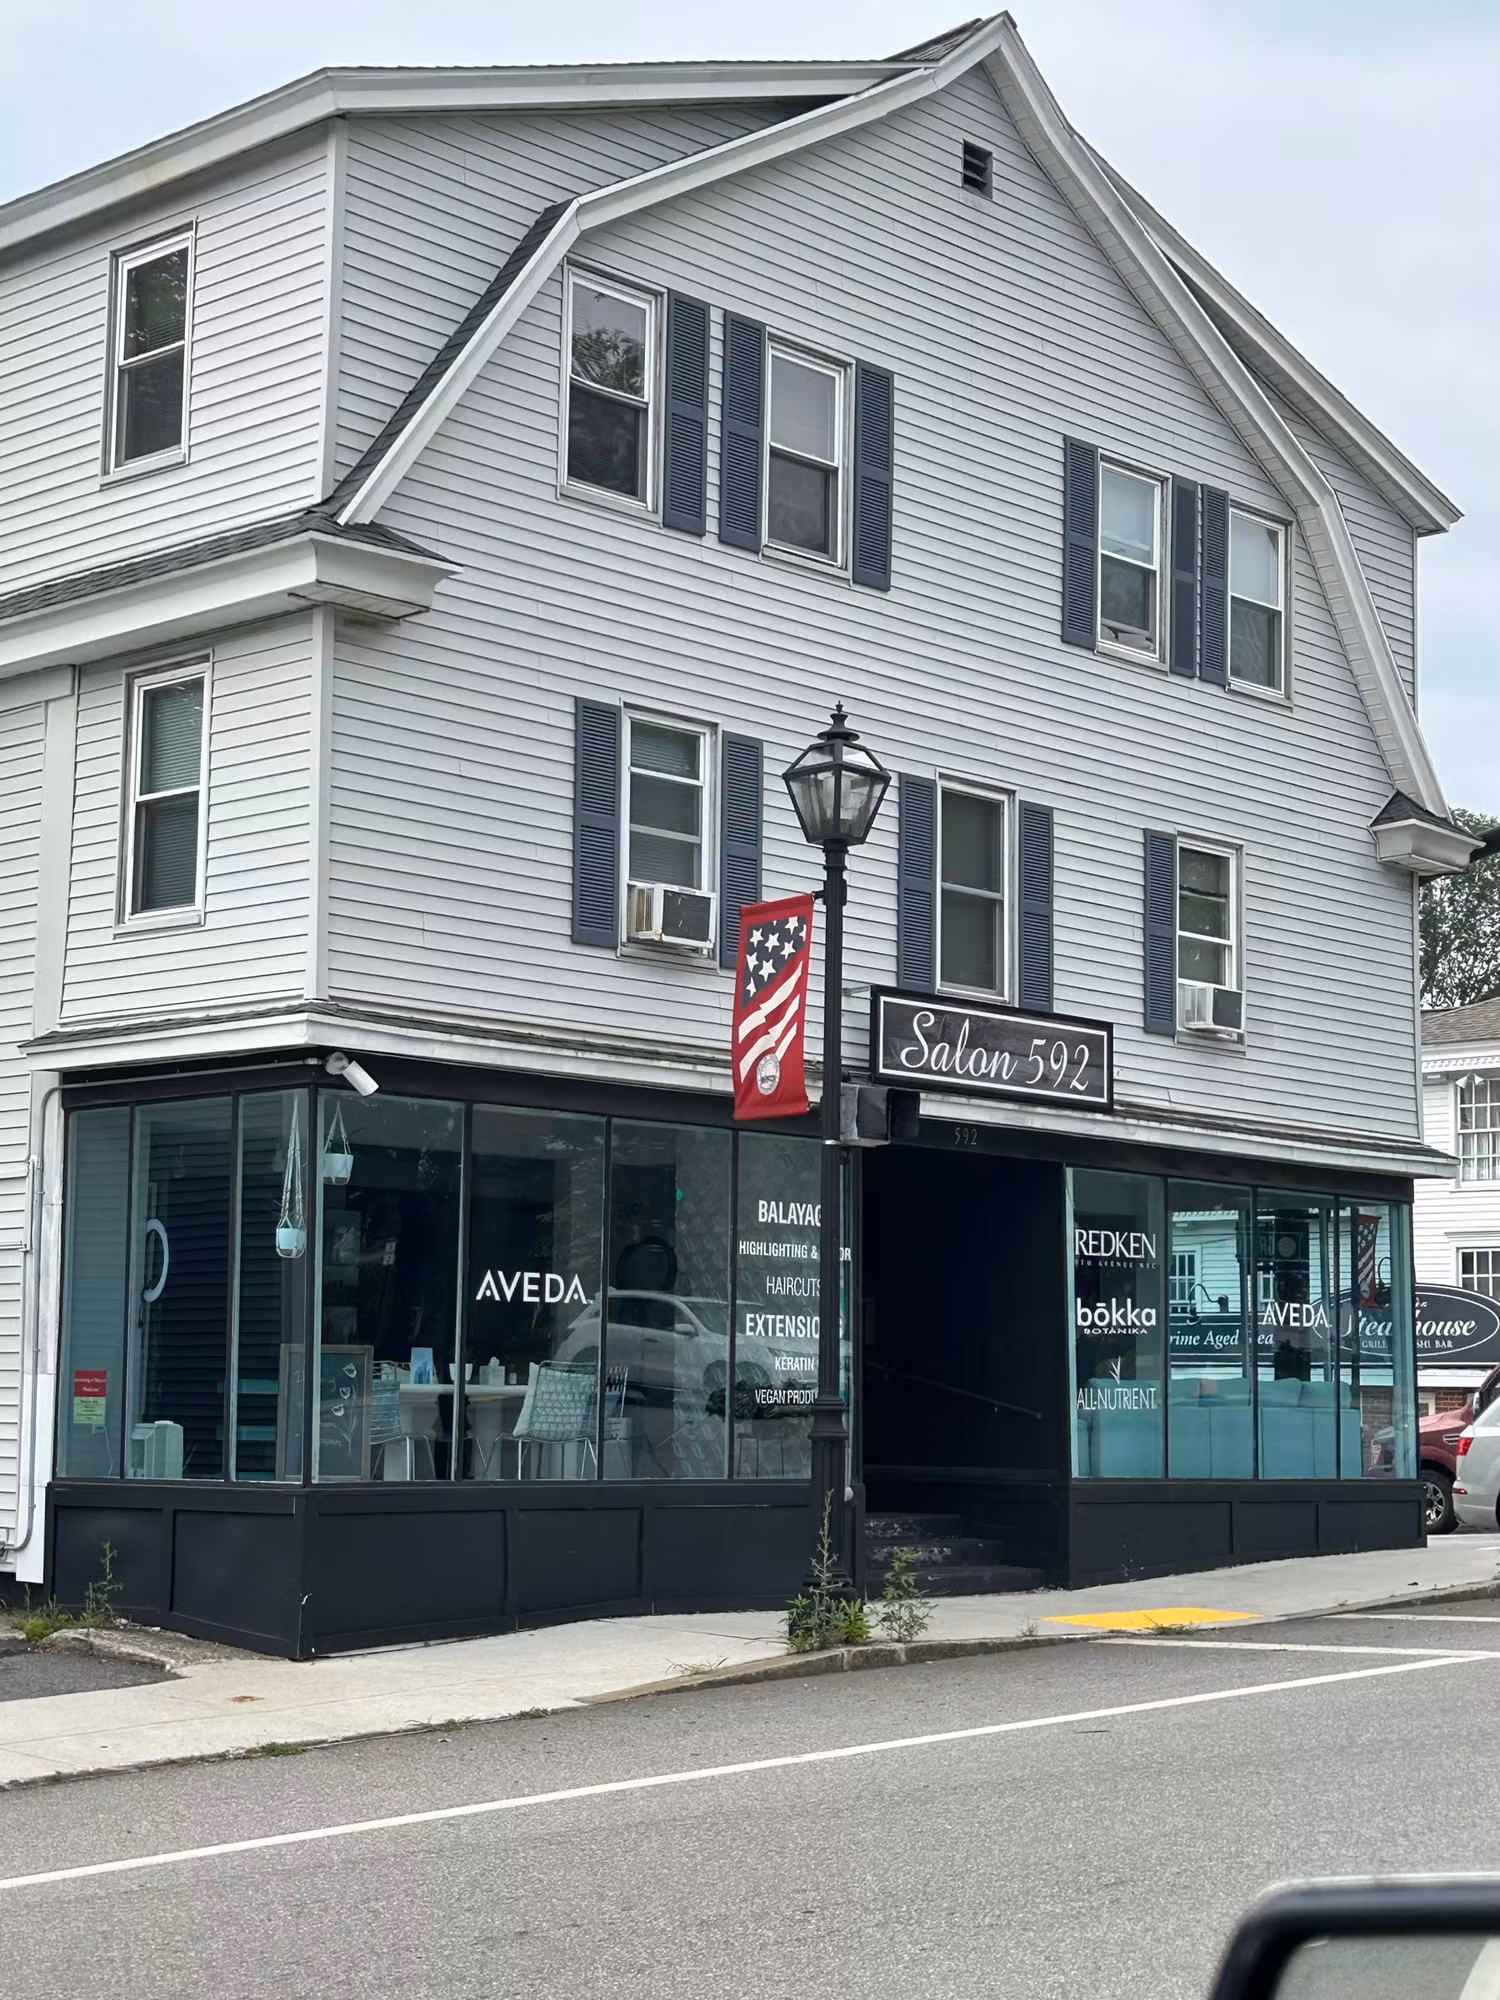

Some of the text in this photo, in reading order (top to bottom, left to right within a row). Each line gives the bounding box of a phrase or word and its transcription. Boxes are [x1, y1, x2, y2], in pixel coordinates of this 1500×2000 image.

[899, 1011, 1089, 1091] Salon 592
[954, 1127, 978, 1145] 592
[758, 1199, 821, 1227] BALAYAG
[739, 1240, 818, 1260] HIGHLIGHTING &
[1075, 1229, 1156, 1258] REDKEN
[475, 1269, 588, 1304] AVEDA
[1076, 1297, 1156, 1326] bōkka
[1263, 1302, 1329, 1328] AVEDA
[1169, 1331, 1200, 1346] rime
[1203, 1329, 1240, 1350] Aged
[1361, 1339, 1388, 1349] GRILL
[1435, 1340, 1454, 1349] BAR
[775, 1356, 815, 1371] KERATIN
[755, 1389, 786, 1404] VEGAN
